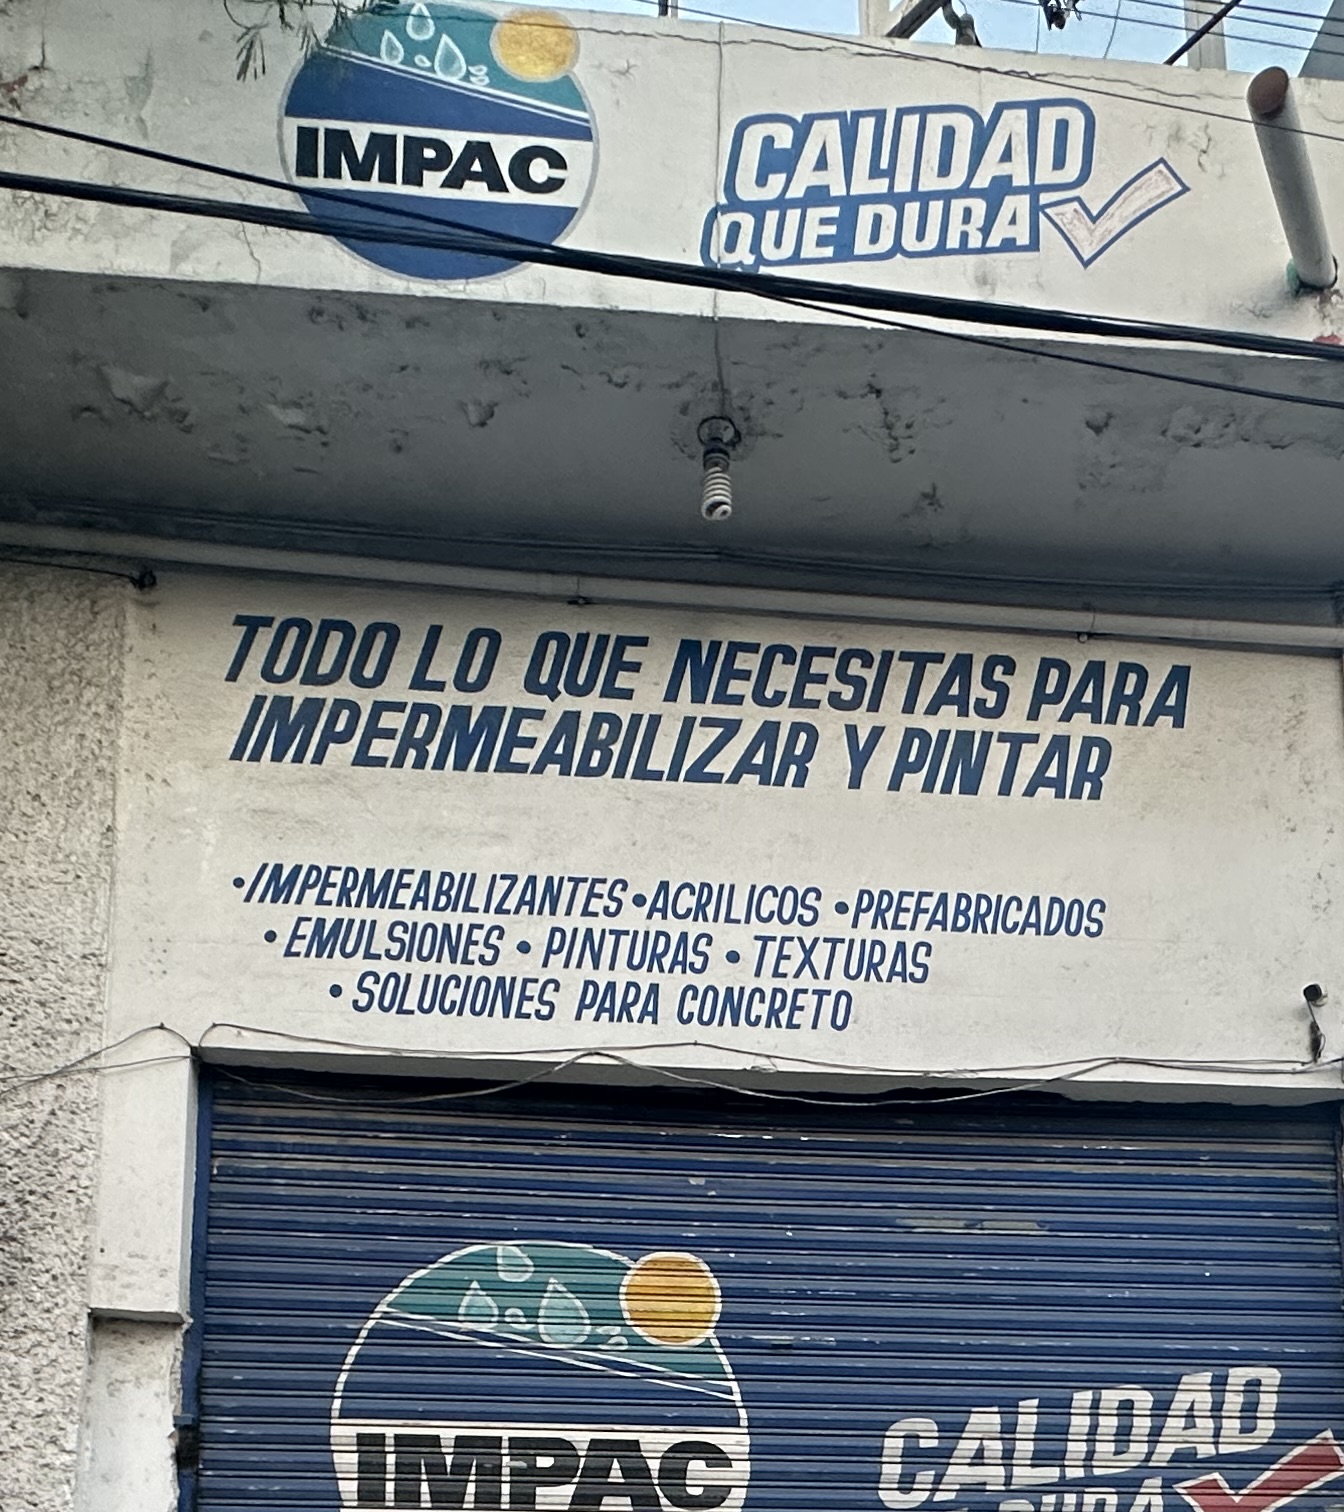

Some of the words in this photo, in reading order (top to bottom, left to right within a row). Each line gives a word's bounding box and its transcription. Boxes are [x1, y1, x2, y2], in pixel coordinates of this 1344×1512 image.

[293, 126, 568, 195] IMPAC
[734, 105, 1086, 202] CALIDAD
[708, 205, 841, 267] QUE
[853, 193, 1031, 257] DURA
[224, 614, 402, 688] TODO
[409, 624, 503, 692] LO
[523, 631, 649, 702] QUE
[663, 639, 1017, 720] NECESITAS
[1026, 656, 1192, 729] PARA
[229, 694, 820, 789] IMPERMEABILIZAR
[844, 724, 886, 790] Y
[887, 727, 1113, 801] PINTAR
[243, 862, 629, 918] IMPERMEABILIZANTES
[645, 881, 823, 927] ACRILICOS
[851, 888, 1107, 939] PREFABRICADOS
[283, 916, 506, 966] EMULSIONES
[542, 926, 713, 974] PINTURAS
[754, 934, 933, 983] TEXTURAS
[352, 971, 561, 1021] SOLUCIONES
[575, 979, 660, 1025] PARA
[676, 985, 854, 1032] CONCRETO
[877, 1365, 1282, 1510] CALIDAD
